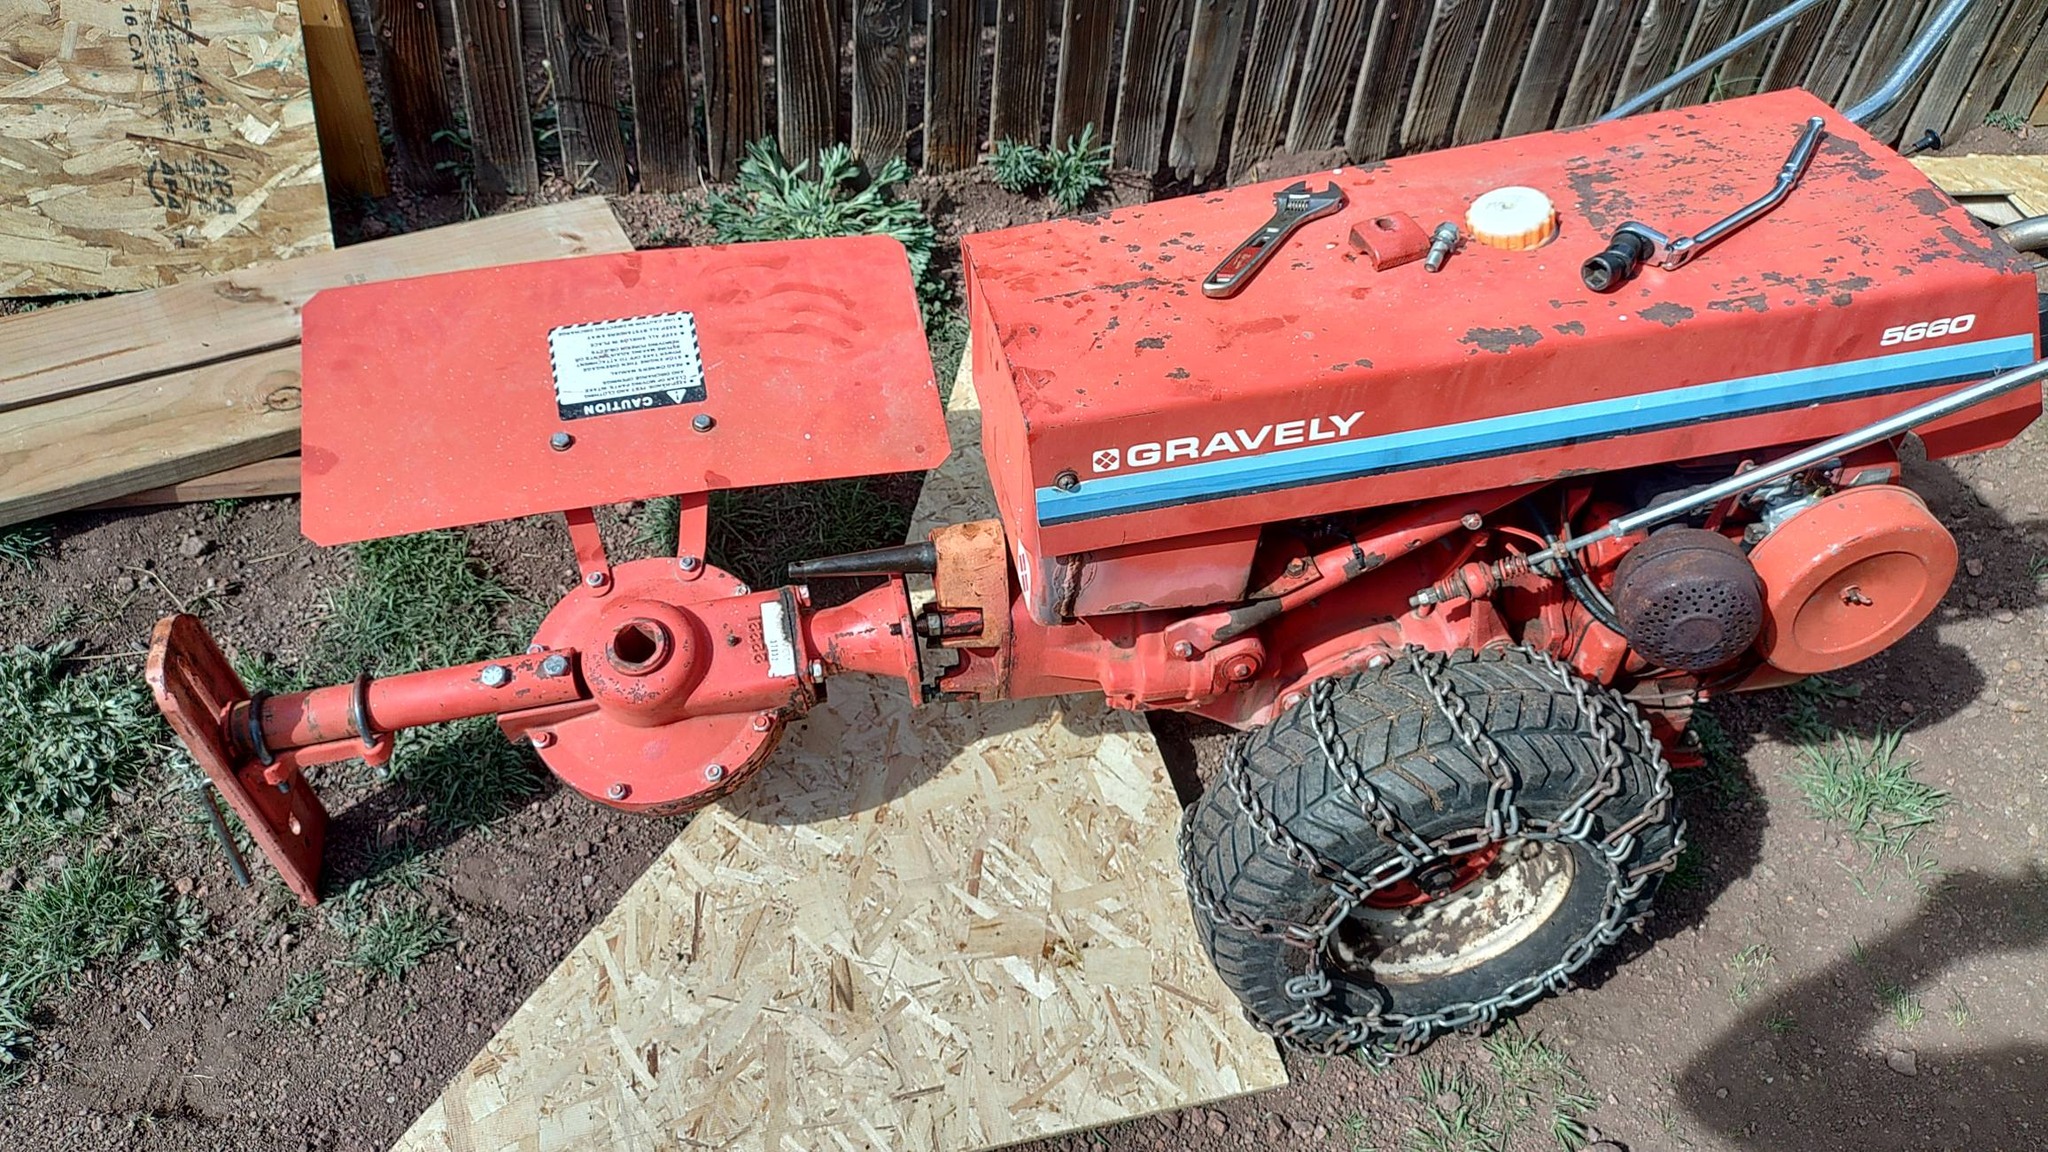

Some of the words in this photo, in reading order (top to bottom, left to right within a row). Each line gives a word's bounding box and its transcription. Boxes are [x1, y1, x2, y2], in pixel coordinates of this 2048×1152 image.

[128, 33, 148, 74] CAT
[1880, 314, 1976, 347] 5660
[583, 396, 652, 415] CAUTION
[1127, 411, 1365, 467] GRAVELY
